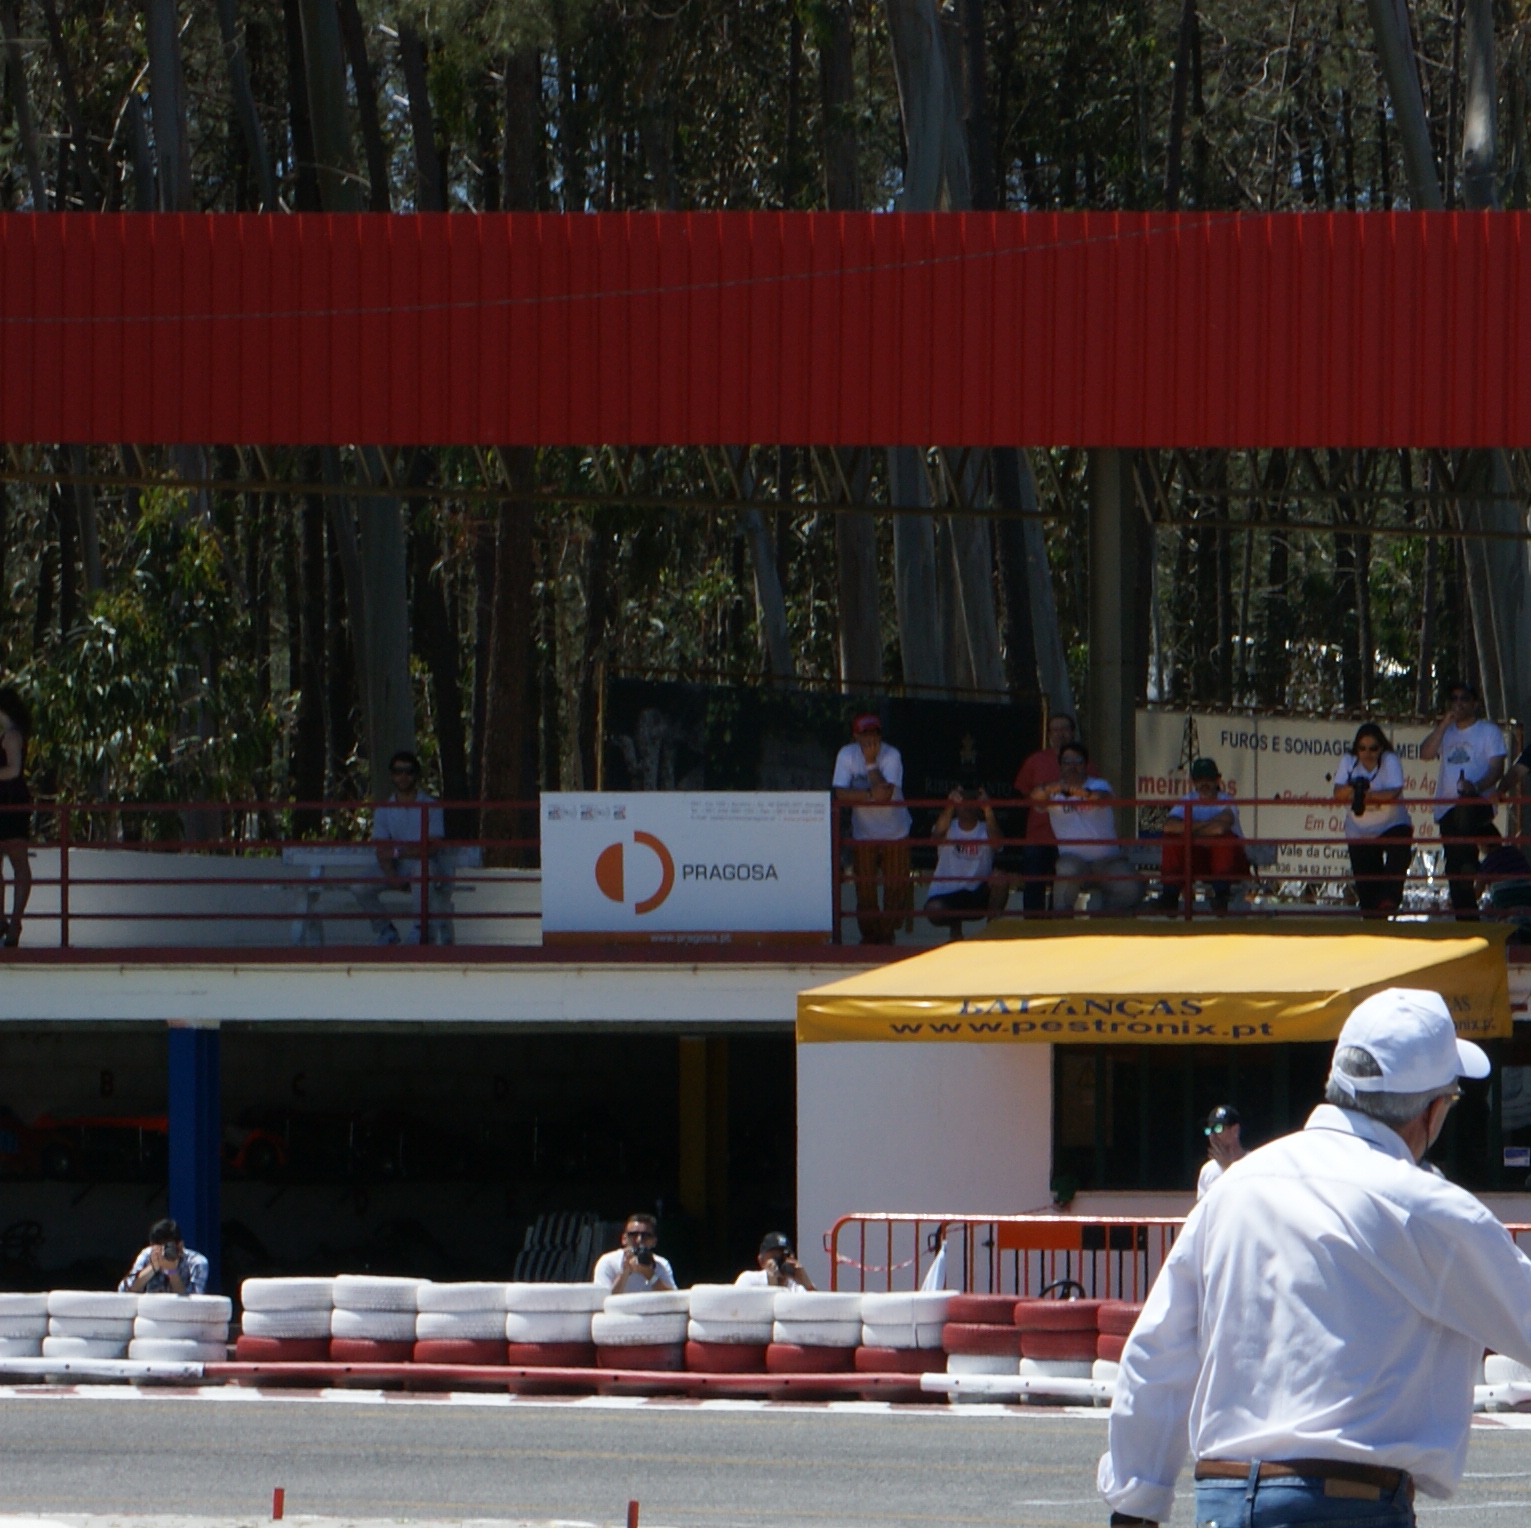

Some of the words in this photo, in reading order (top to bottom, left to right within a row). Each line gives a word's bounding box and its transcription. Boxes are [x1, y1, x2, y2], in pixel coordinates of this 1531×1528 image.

[1221, 730, 1268, 751] FUROS
[1272, 736, 1281, 753] E
[1284, 736, 1352, 756] SONDAGE
[1280, 844, 1303, 858] Vale
[1307, 845, 1320, 858] da
[682, 863, 778, 881] PRAGOSA
[890, 1017, 1275, 1038] www.pestronix.pt
